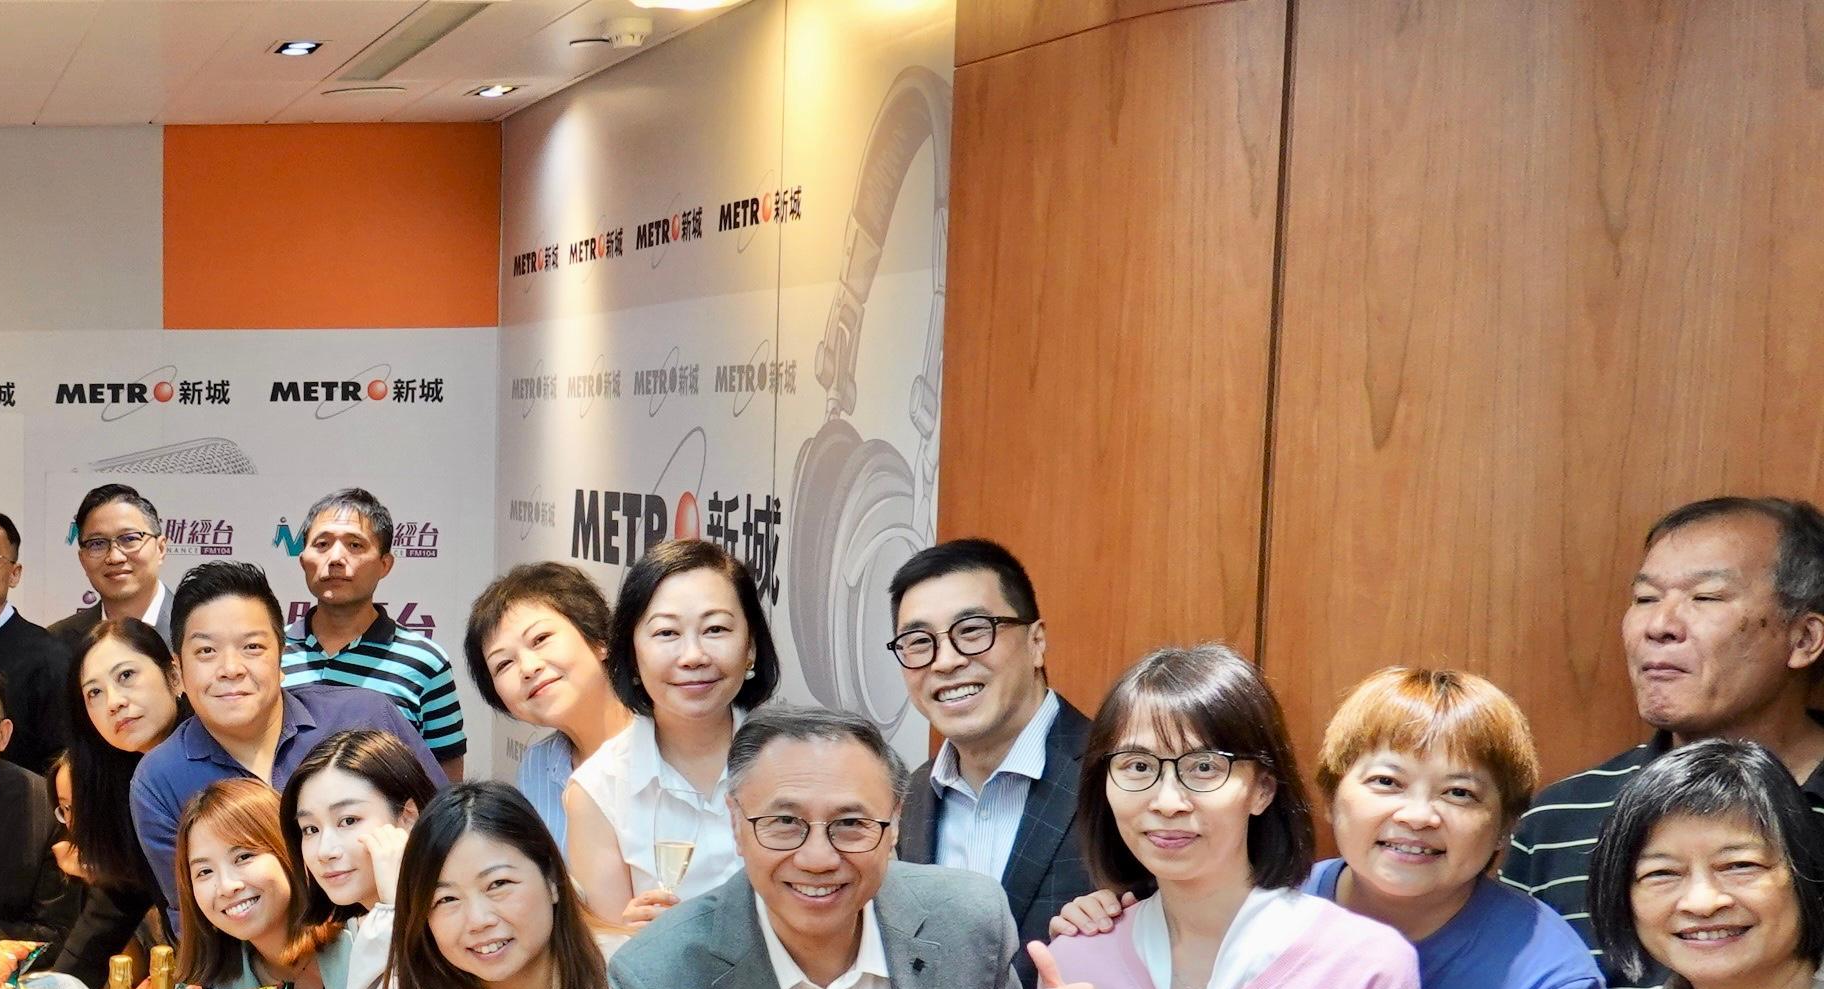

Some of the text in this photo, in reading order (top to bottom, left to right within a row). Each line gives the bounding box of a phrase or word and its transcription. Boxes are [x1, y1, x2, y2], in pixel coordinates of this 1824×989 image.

[718, 185, 802, 232] METRO 新城
[606, 227, 623, 258] 新城
[636, 206, 703, 250] METRO 新城
[544, 243, 559, 272] 新城
[55, 380, 231, 405] METRO 新城
[270, 378, 444, 404] METRO 新城
[678, 364, 699, 396] 新城
[768, 360, 797, 395] 新城
[203, 547, 232, 555] FM104
[409, 549, 436, 557] FM104
